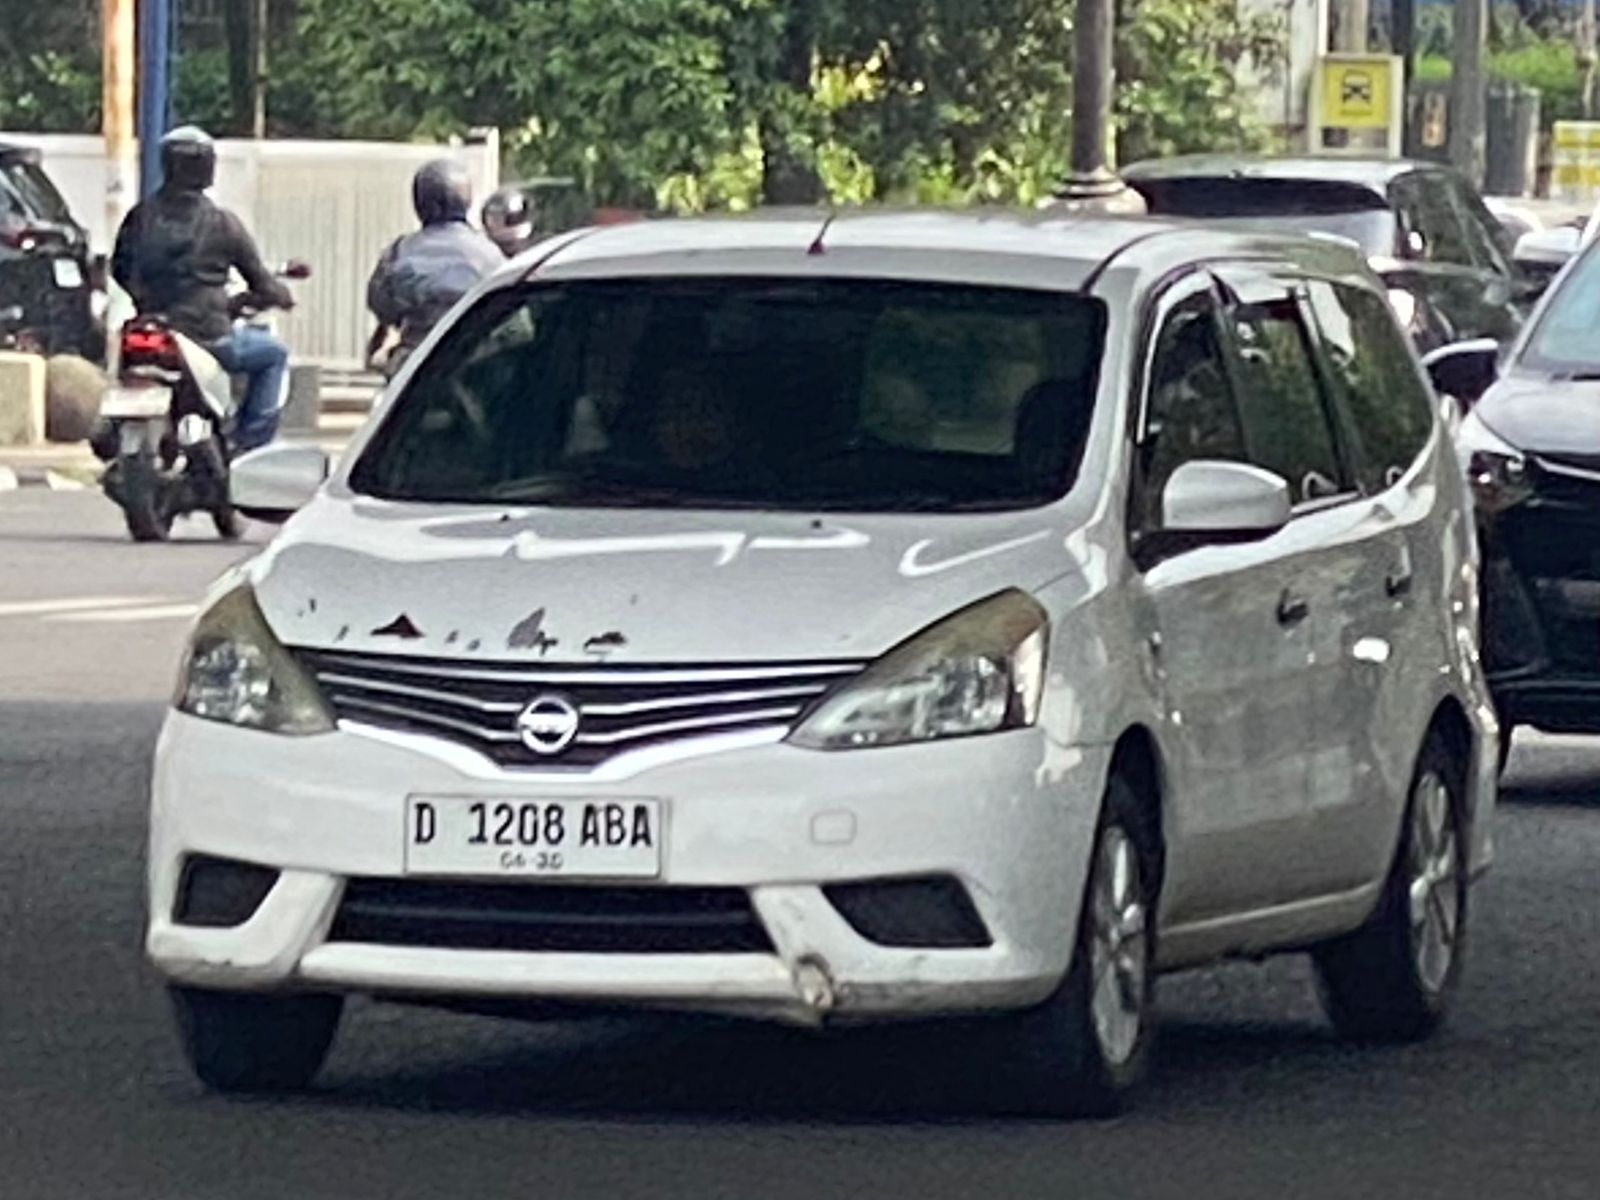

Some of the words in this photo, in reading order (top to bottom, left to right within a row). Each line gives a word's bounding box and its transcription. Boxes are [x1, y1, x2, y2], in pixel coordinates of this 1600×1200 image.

[414, 803, 436, 844] D
[468, 803, 566, 846] 1208
[580, 804, 653, 848] ABA
